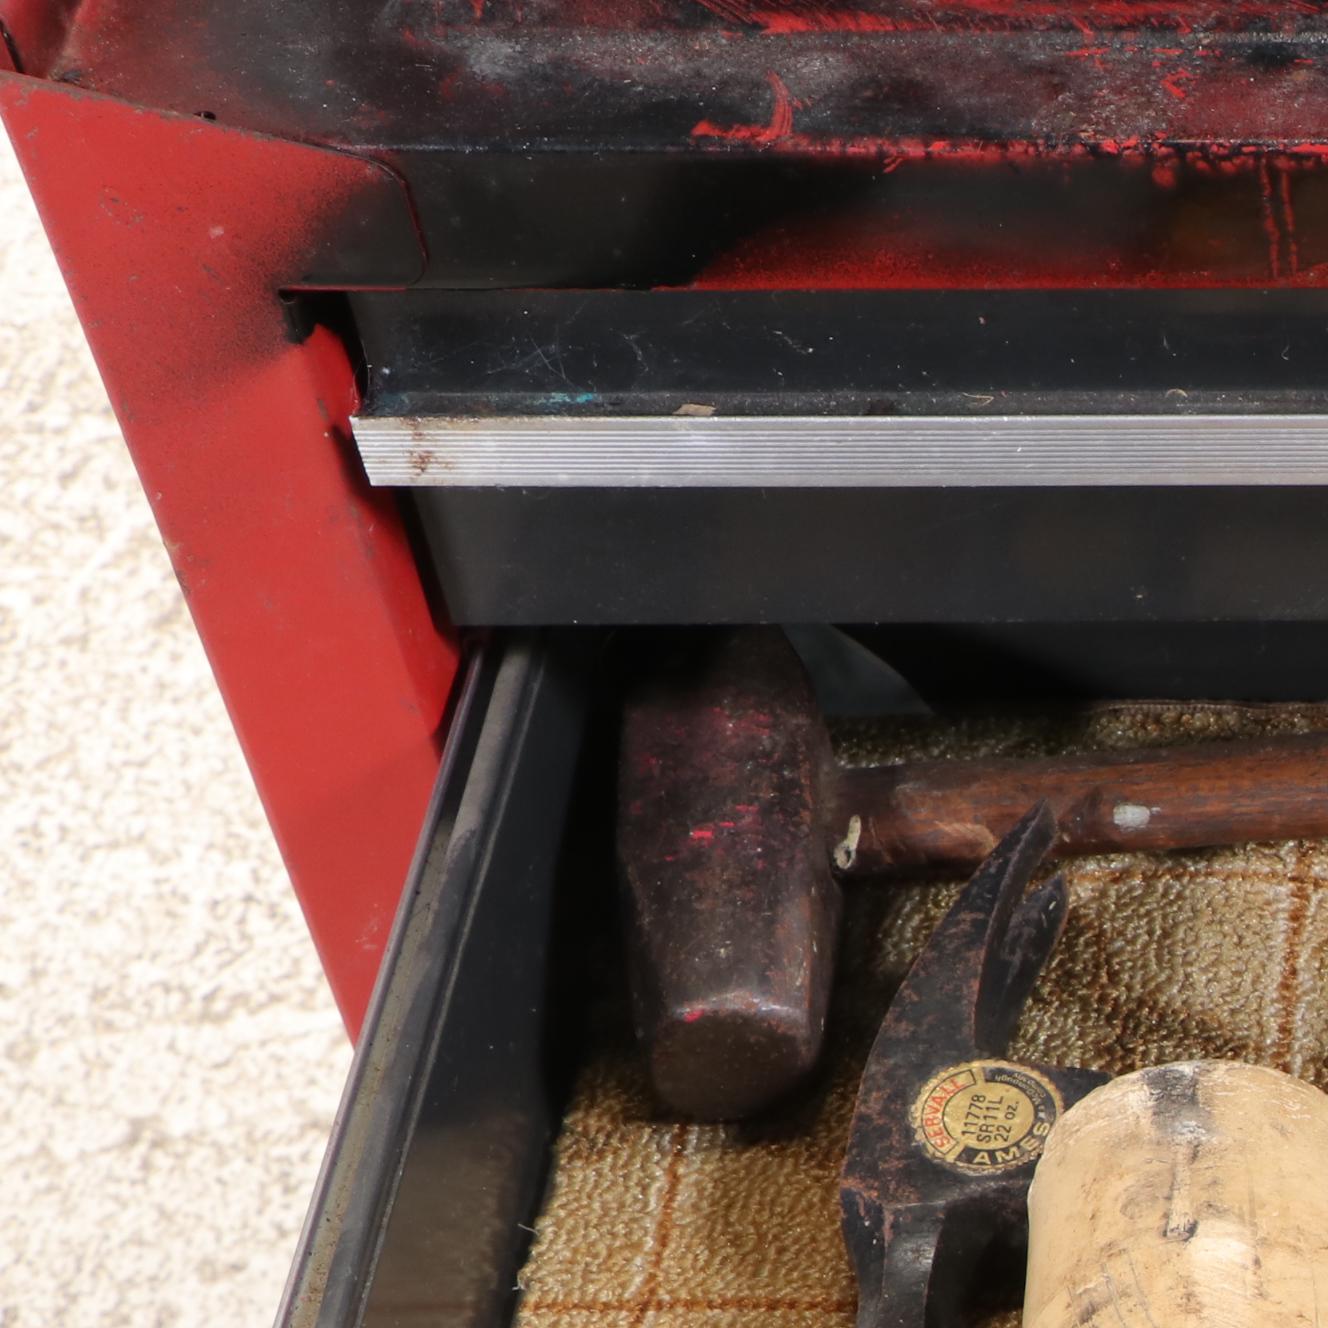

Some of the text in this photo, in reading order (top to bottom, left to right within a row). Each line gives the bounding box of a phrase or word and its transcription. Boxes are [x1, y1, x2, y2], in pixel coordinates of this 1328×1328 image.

[961, 1094, 986, 1136] 11778
[976, 1096, 1004, 1143] SR11L
[993, 1101, 1019, 1142] 22 oz.
[972, 1122, 1050, 1164] AMES
